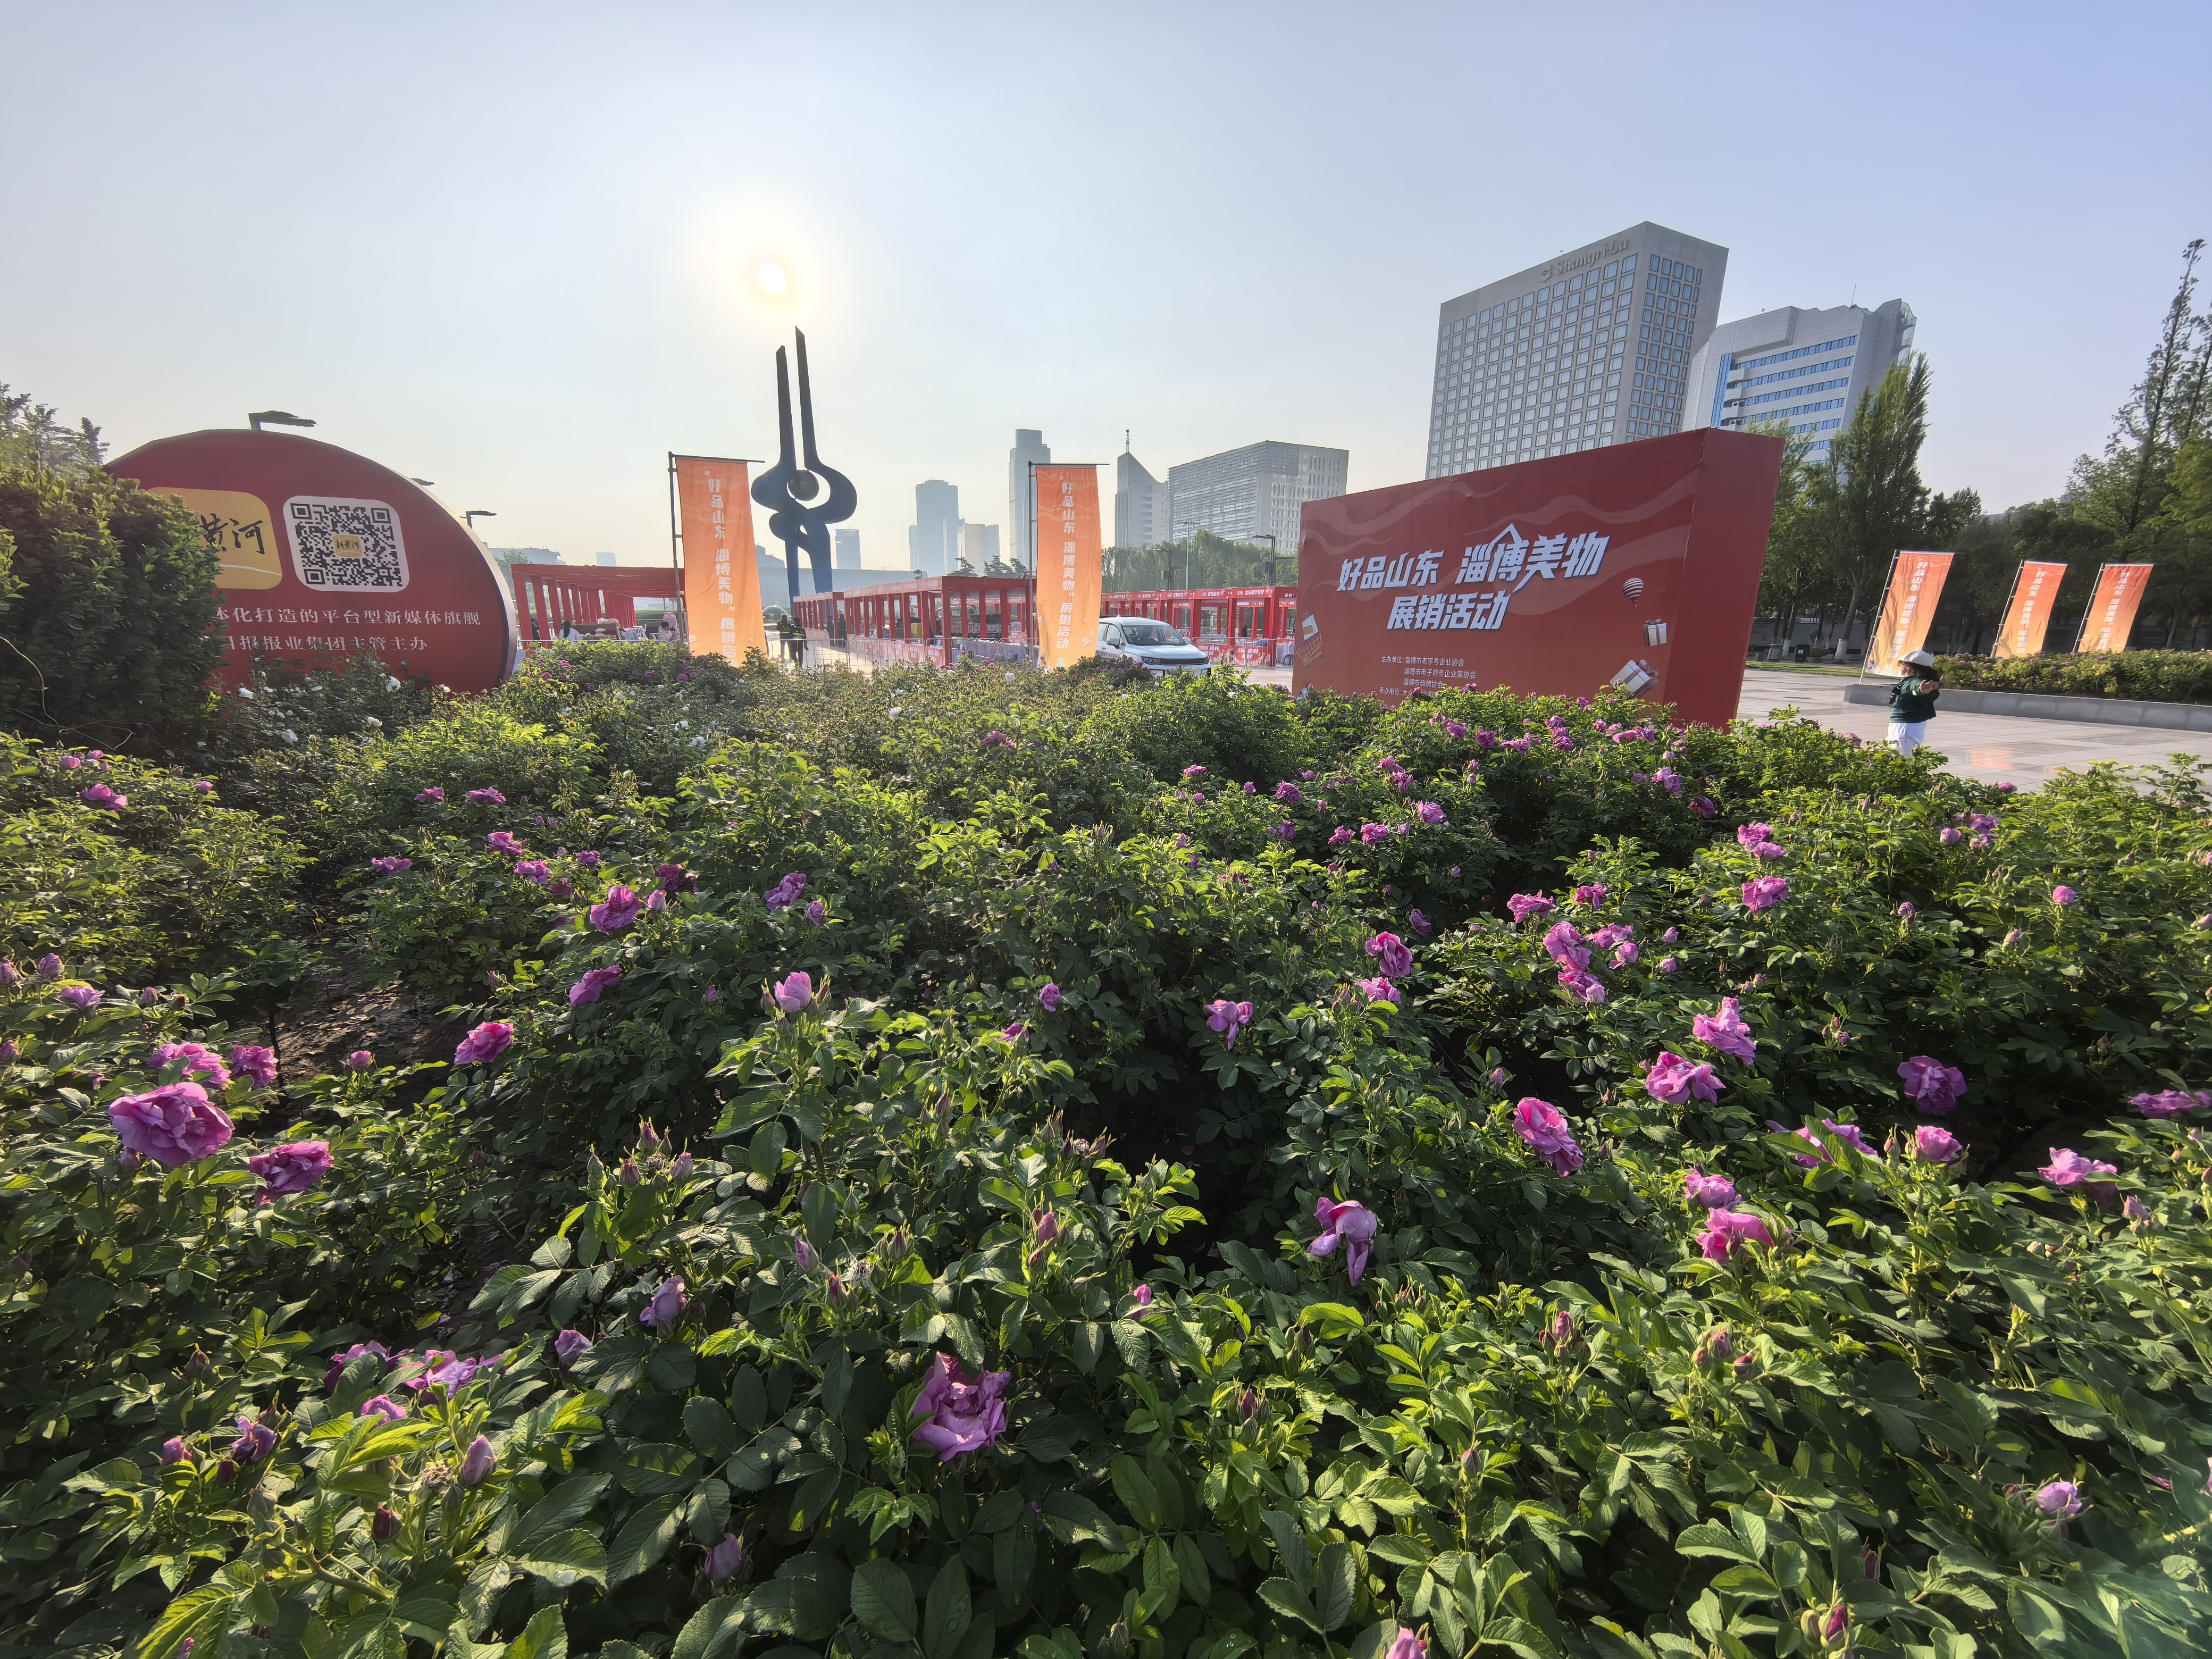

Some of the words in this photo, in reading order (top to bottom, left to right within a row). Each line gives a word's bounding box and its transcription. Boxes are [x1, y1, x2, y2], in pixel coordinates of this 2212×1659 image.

[1556, 239, 1628, 276] Shangri-La
[1336, 549, 1445, 591] 好品山东
[1455, 523, 1611, 593] 淄博美物
[1386, 590, 1513, 630] 展销活动
